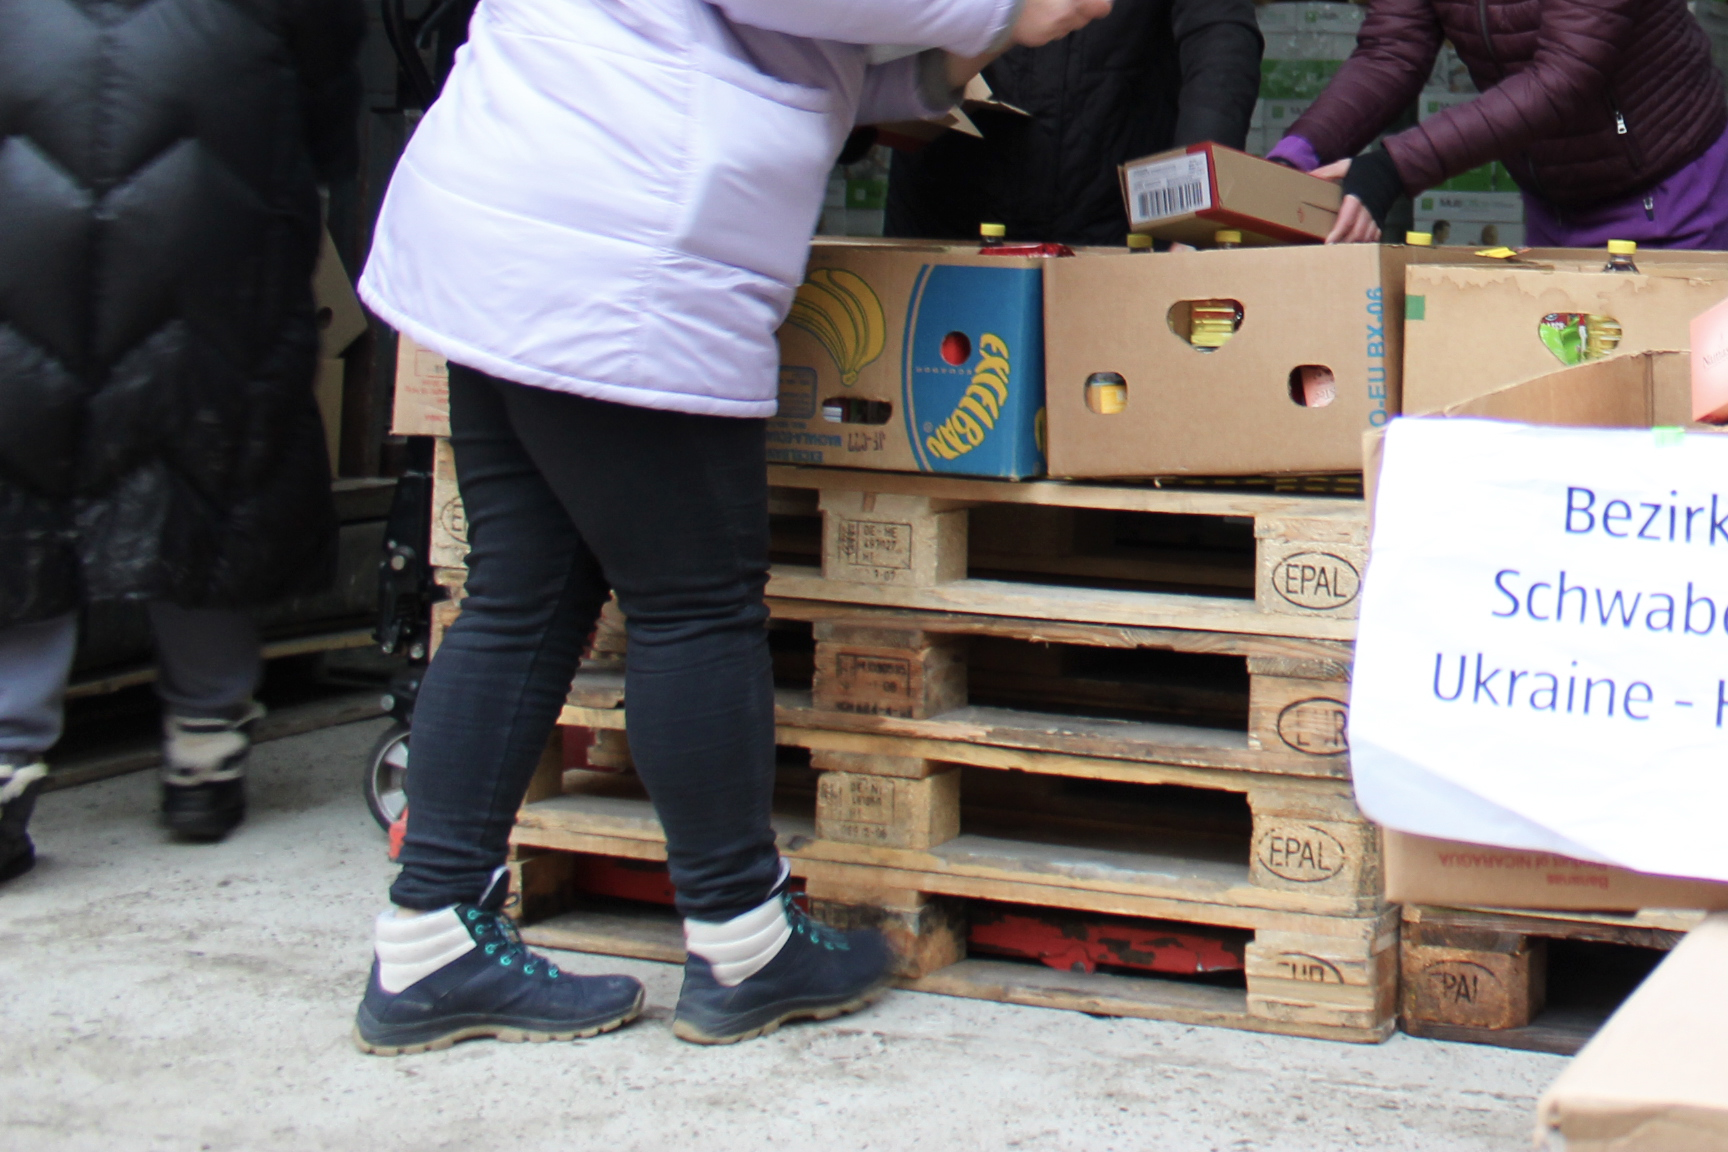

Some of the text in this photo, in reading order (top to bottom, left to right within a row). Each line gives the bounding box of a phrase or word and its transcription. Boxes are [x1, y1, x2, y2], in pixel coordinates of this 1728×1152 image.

[1365, 287, 1385, 358] BX-06
[926, 333, 1010, 460] EXCELBAN
[1285, 564, 1347, 598] EPAL
[1431, 652, 1654, 721] Ukraine
[1270, 836, 1332, 871] EPAL
